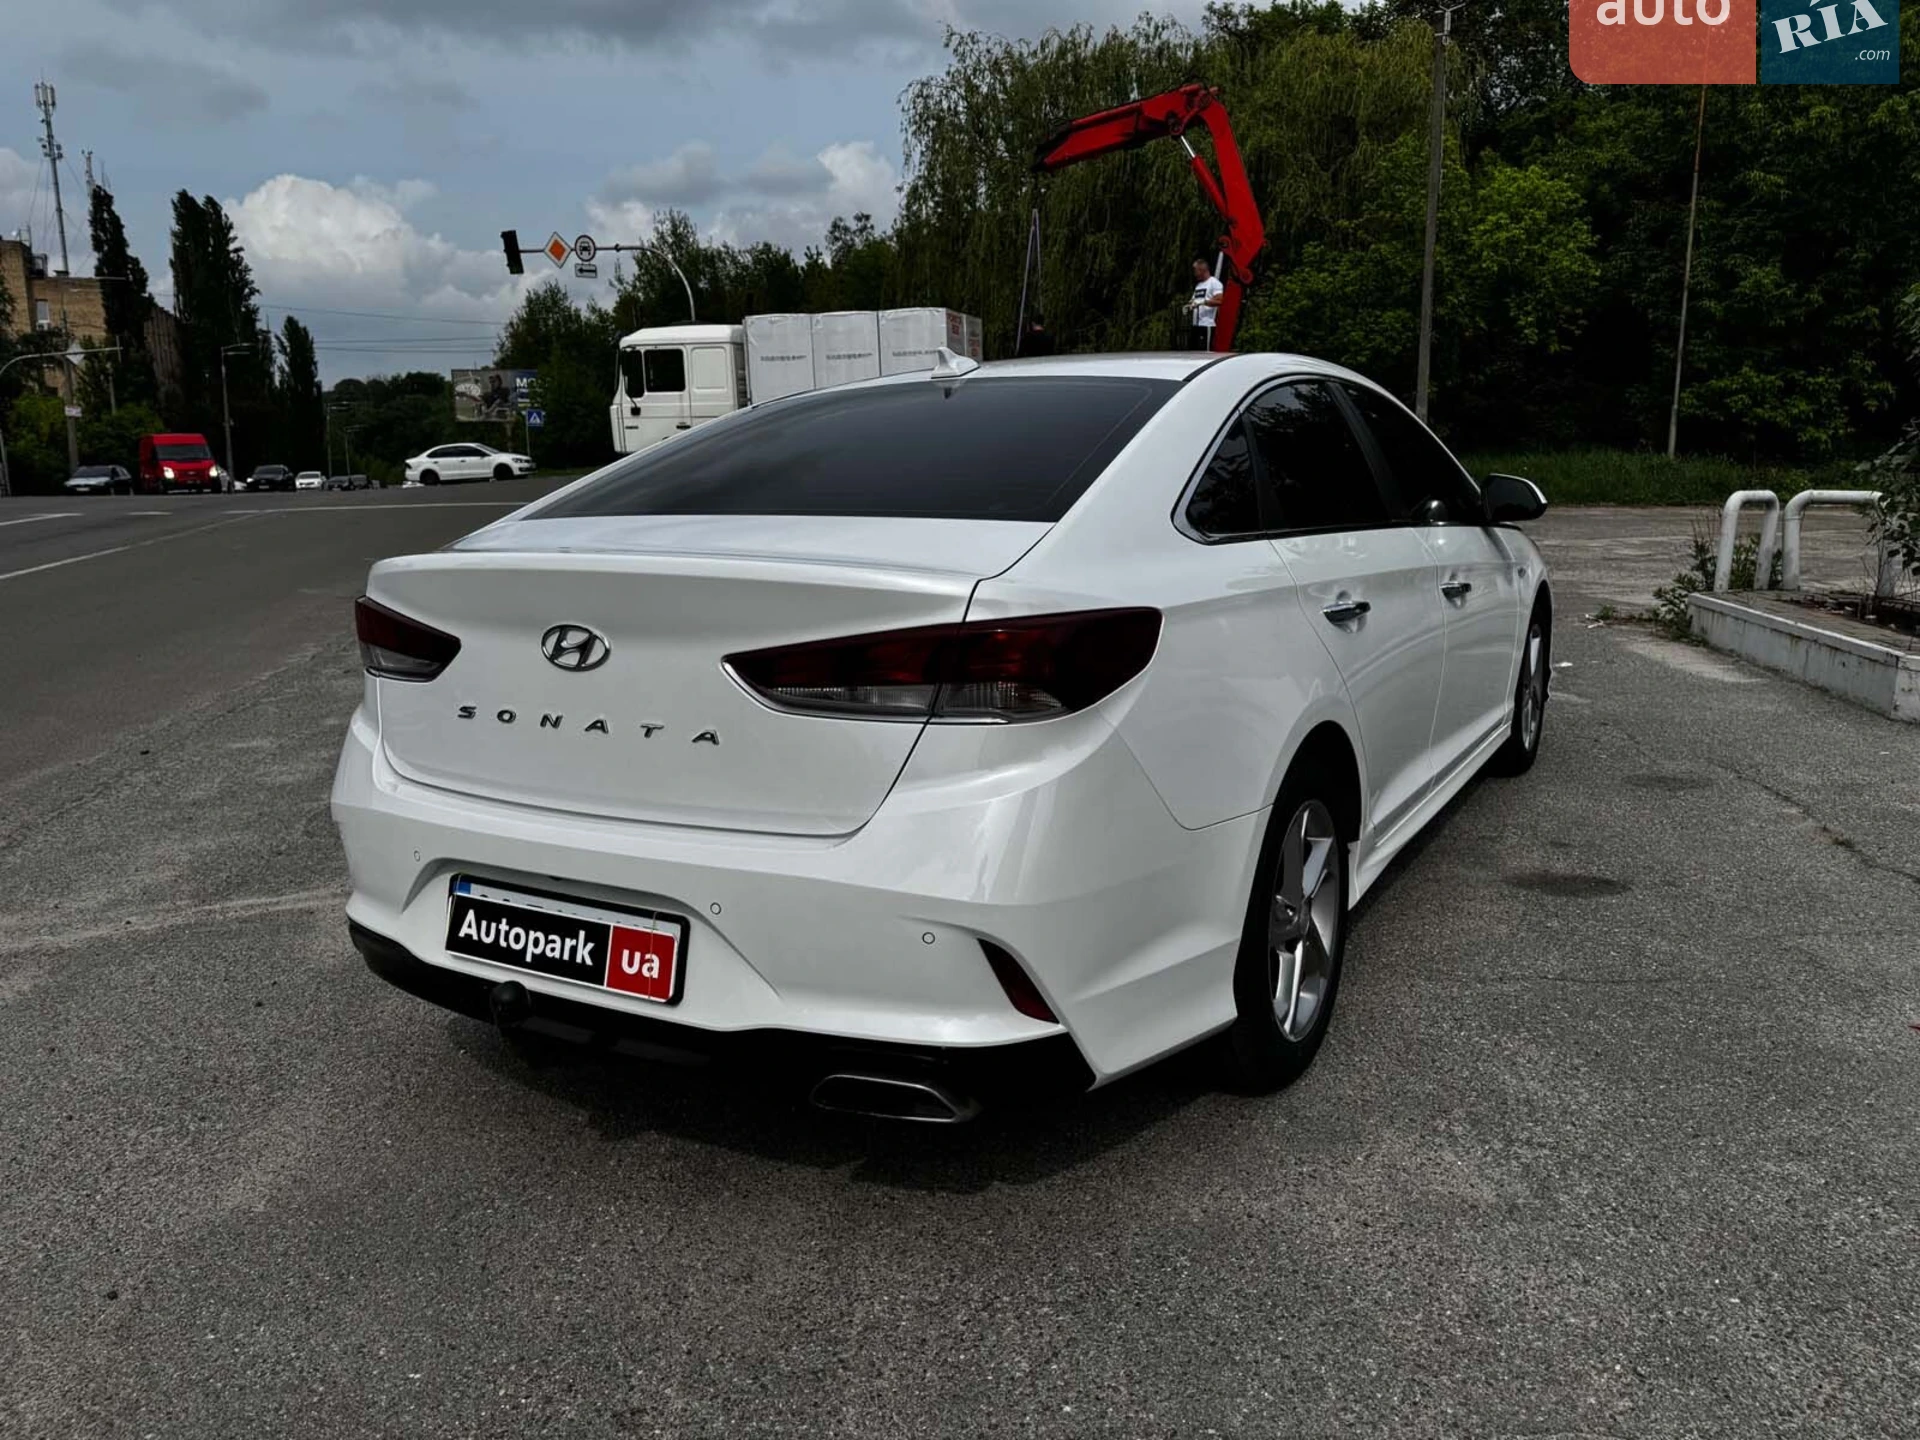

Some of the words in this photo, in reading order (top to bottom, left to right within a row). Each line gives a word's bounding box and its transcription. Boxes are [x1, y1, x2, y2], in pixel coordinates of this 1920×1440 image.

[457, 705, 720, 746] SONATA
[458, 909, 596, 966] Autopark
[620, 948, 661, 979] ua
